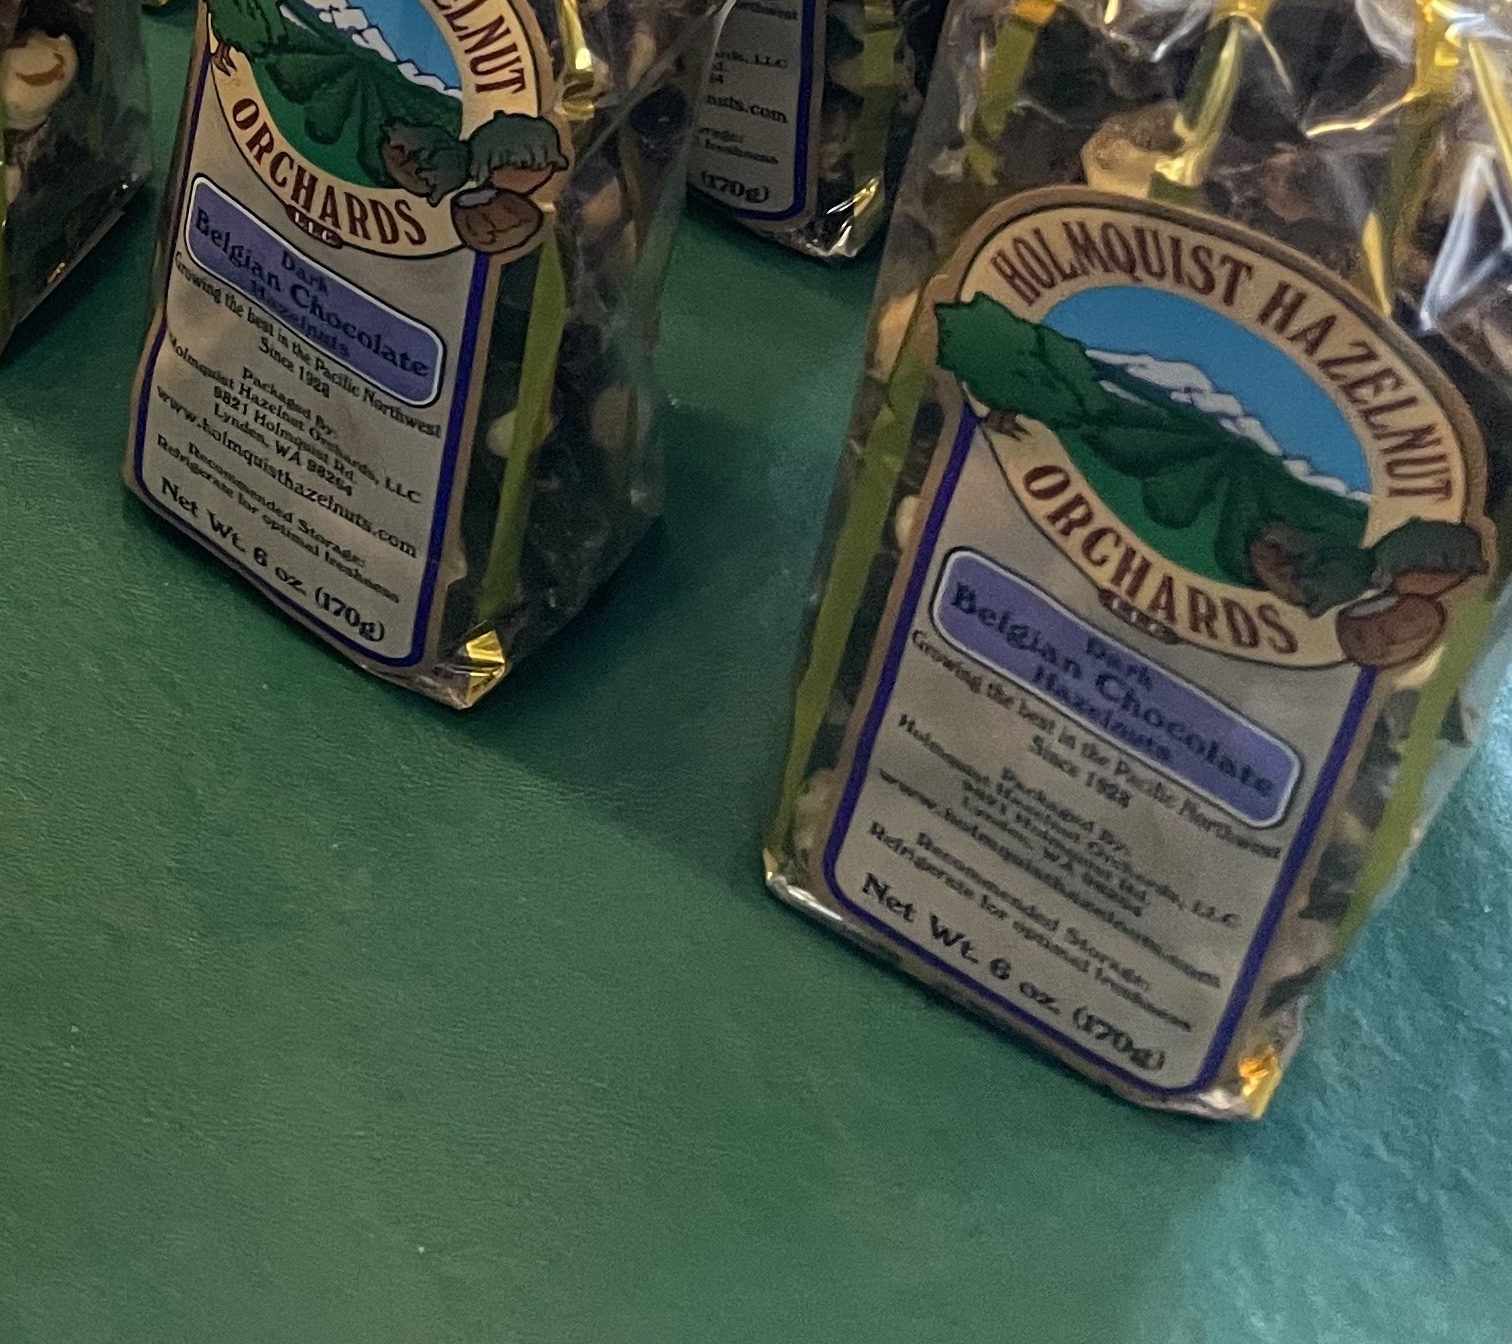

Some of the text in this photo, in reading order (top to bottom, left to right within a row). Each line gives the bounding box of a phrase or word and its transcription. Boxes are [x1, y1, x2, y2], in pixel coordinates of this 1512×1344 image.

[232, 97, 428, 246] ORCHARDS
[174, 250, 443, 439] Growing the best in the Pacific Northwest
[194, 207, 431, 378] Belgian Chocolate
[281, 249, 329, 296] Dark
[258, 334, 295, 374] Since
[989, 219, 1455, 502] HOLMQUIST HAZELNUT
[156, 385, 418, 559] www.holmquisthazelnuts.com
[187, 441, 294, 525] Recommended
[237, 381, 305, 432] Hazelnut
[384, 474, 423, 505] LLC
[252, 409, 334, 466] Holmquist
[273, 440, 303, 467] WA
[159, 474, 386, 643] Net Wt. 6 oz. (170g)
[1022, 463, 1299, 656] ORCHARDS
[950, 580, 1276, 798] Belgian Chocolate
[1085, 634, 1155, 693] Dark
[860, 871, 917, 924] Net
[928, 911, 980, 965] Wt.
[1071, 1004, 1167, 1072] (170g)
